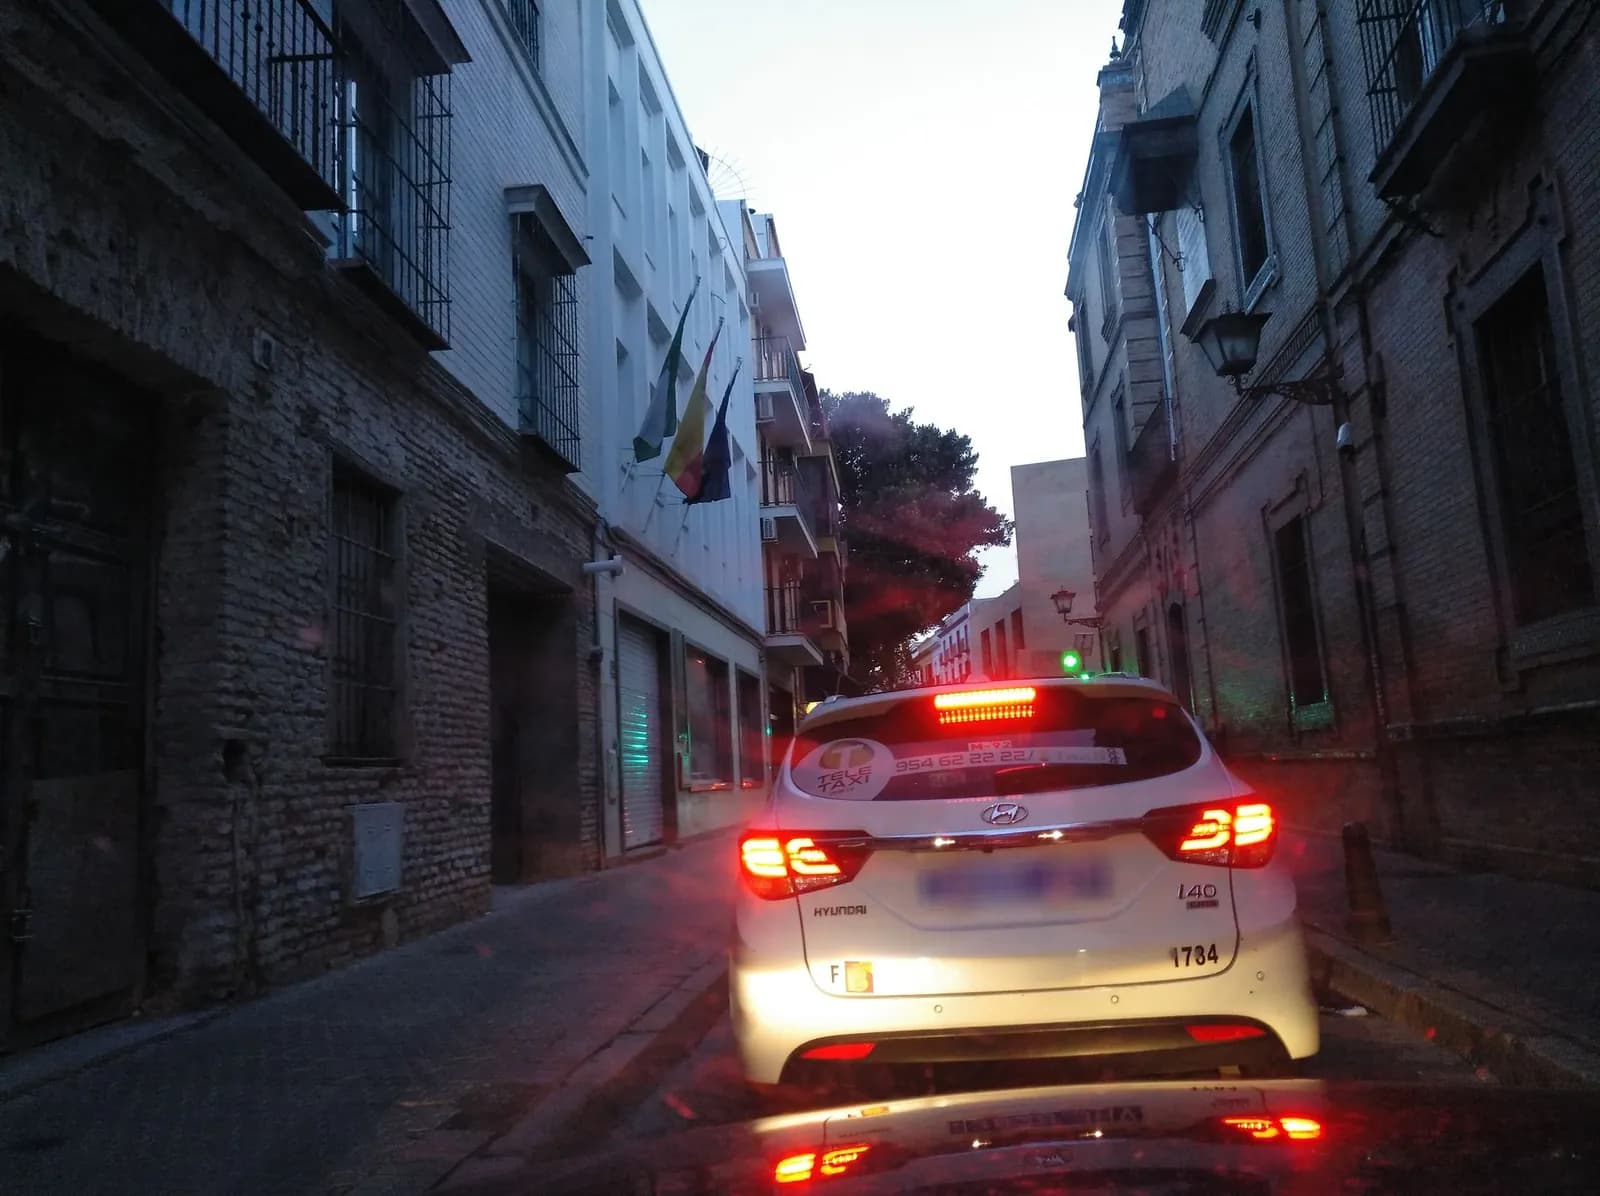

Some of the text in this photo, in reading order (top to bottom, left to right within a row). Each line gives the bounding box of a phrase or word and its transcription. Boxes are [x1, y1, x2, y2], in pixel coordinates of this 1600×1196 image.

[896, 757, 934, 773] 954
[938, 754, 965, 767] 62
[969, 752, 994, 764] 22
[817, 766, 872, 784] TELE
[817, 775, 870, 793] TAXI
[814, 905, 867, 917] HYUNDAI
[1170, 943, 1219, 968] 1734
